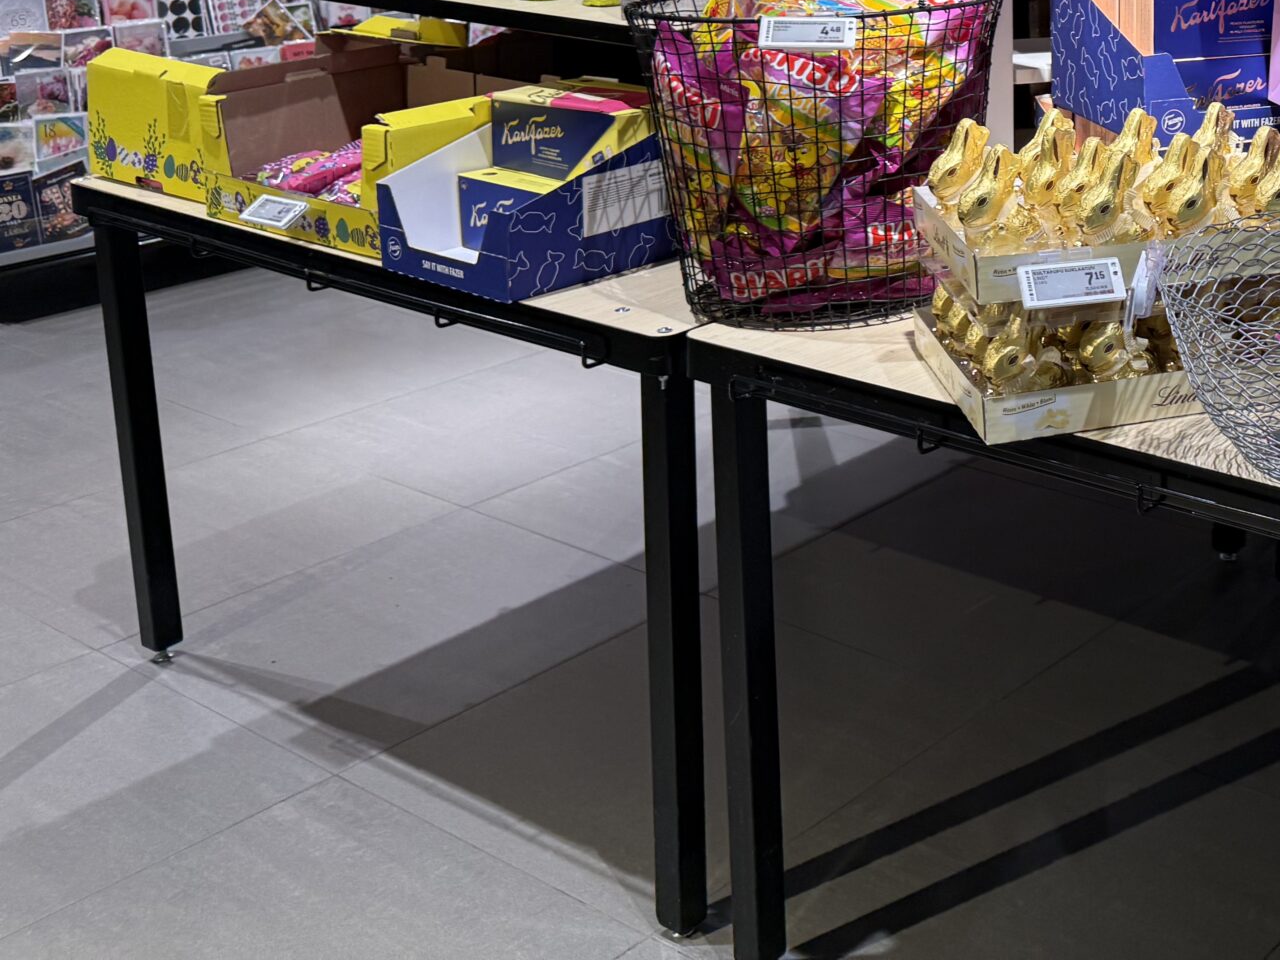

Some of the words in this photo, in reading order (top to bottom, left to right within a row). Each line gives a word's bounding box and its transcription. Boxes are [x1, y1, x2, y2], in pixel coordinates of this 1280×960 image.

[1233, 119, 1239, 129] IT
[1241, 117, 1260, 128] WITH
[44, 123, 57, 138] 18
